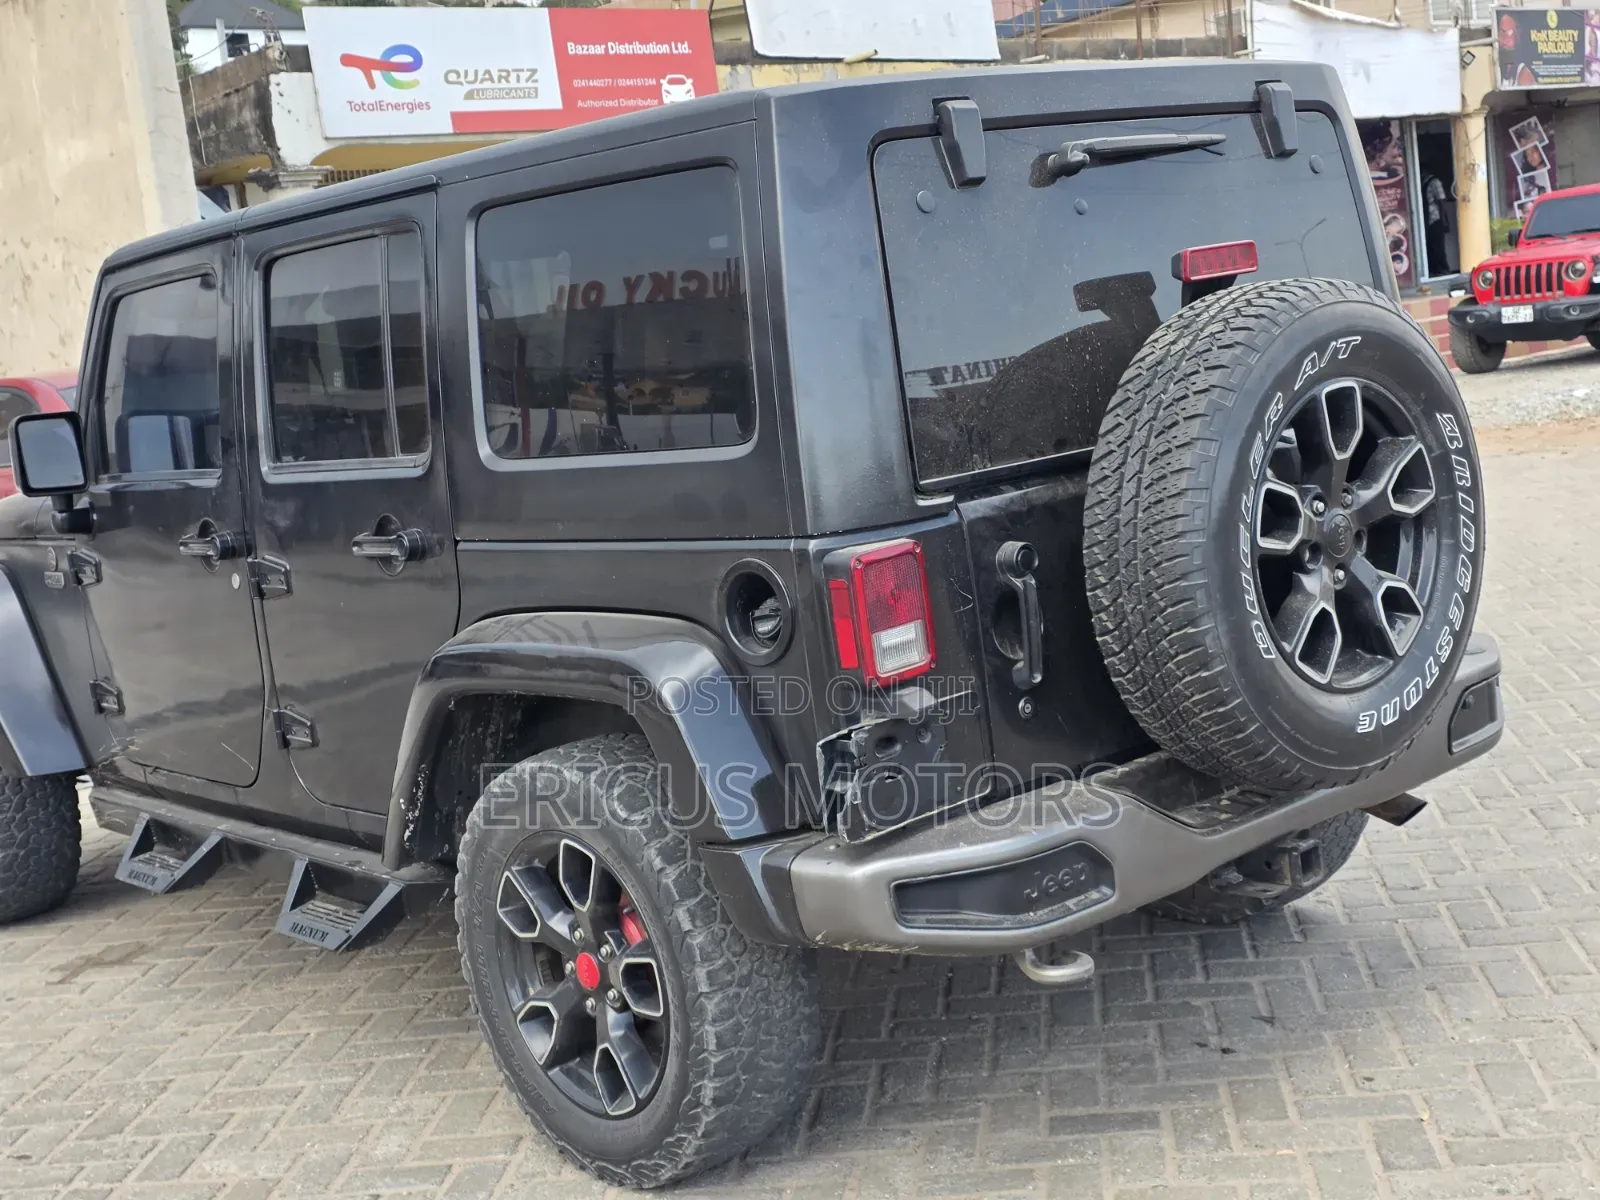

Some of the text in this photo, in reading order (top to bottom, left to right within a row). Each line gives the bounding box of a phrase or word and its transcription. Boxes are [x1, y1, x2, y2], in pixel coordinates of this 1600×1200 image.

[1548, 29, 1579, 42] BEAUTY
[567, 40, 693, 55] Bazaar Distribution Ltd.
[1537, 41, 1575, 54] PARLOUR
[443, 68, 539, 86] QUARTZ
[473, 88, 537, 99] LUBRICANTS
[346, 98, 431, 114] TotalEnergies
[577, 97, 659, 108] Authorized Distributor
[1239, 335, 1362, 660] DUELER A/T
[1356, 412, 1475, 734] BRIDGESTONE
[289, 921, 329, 942] MAGNUM
